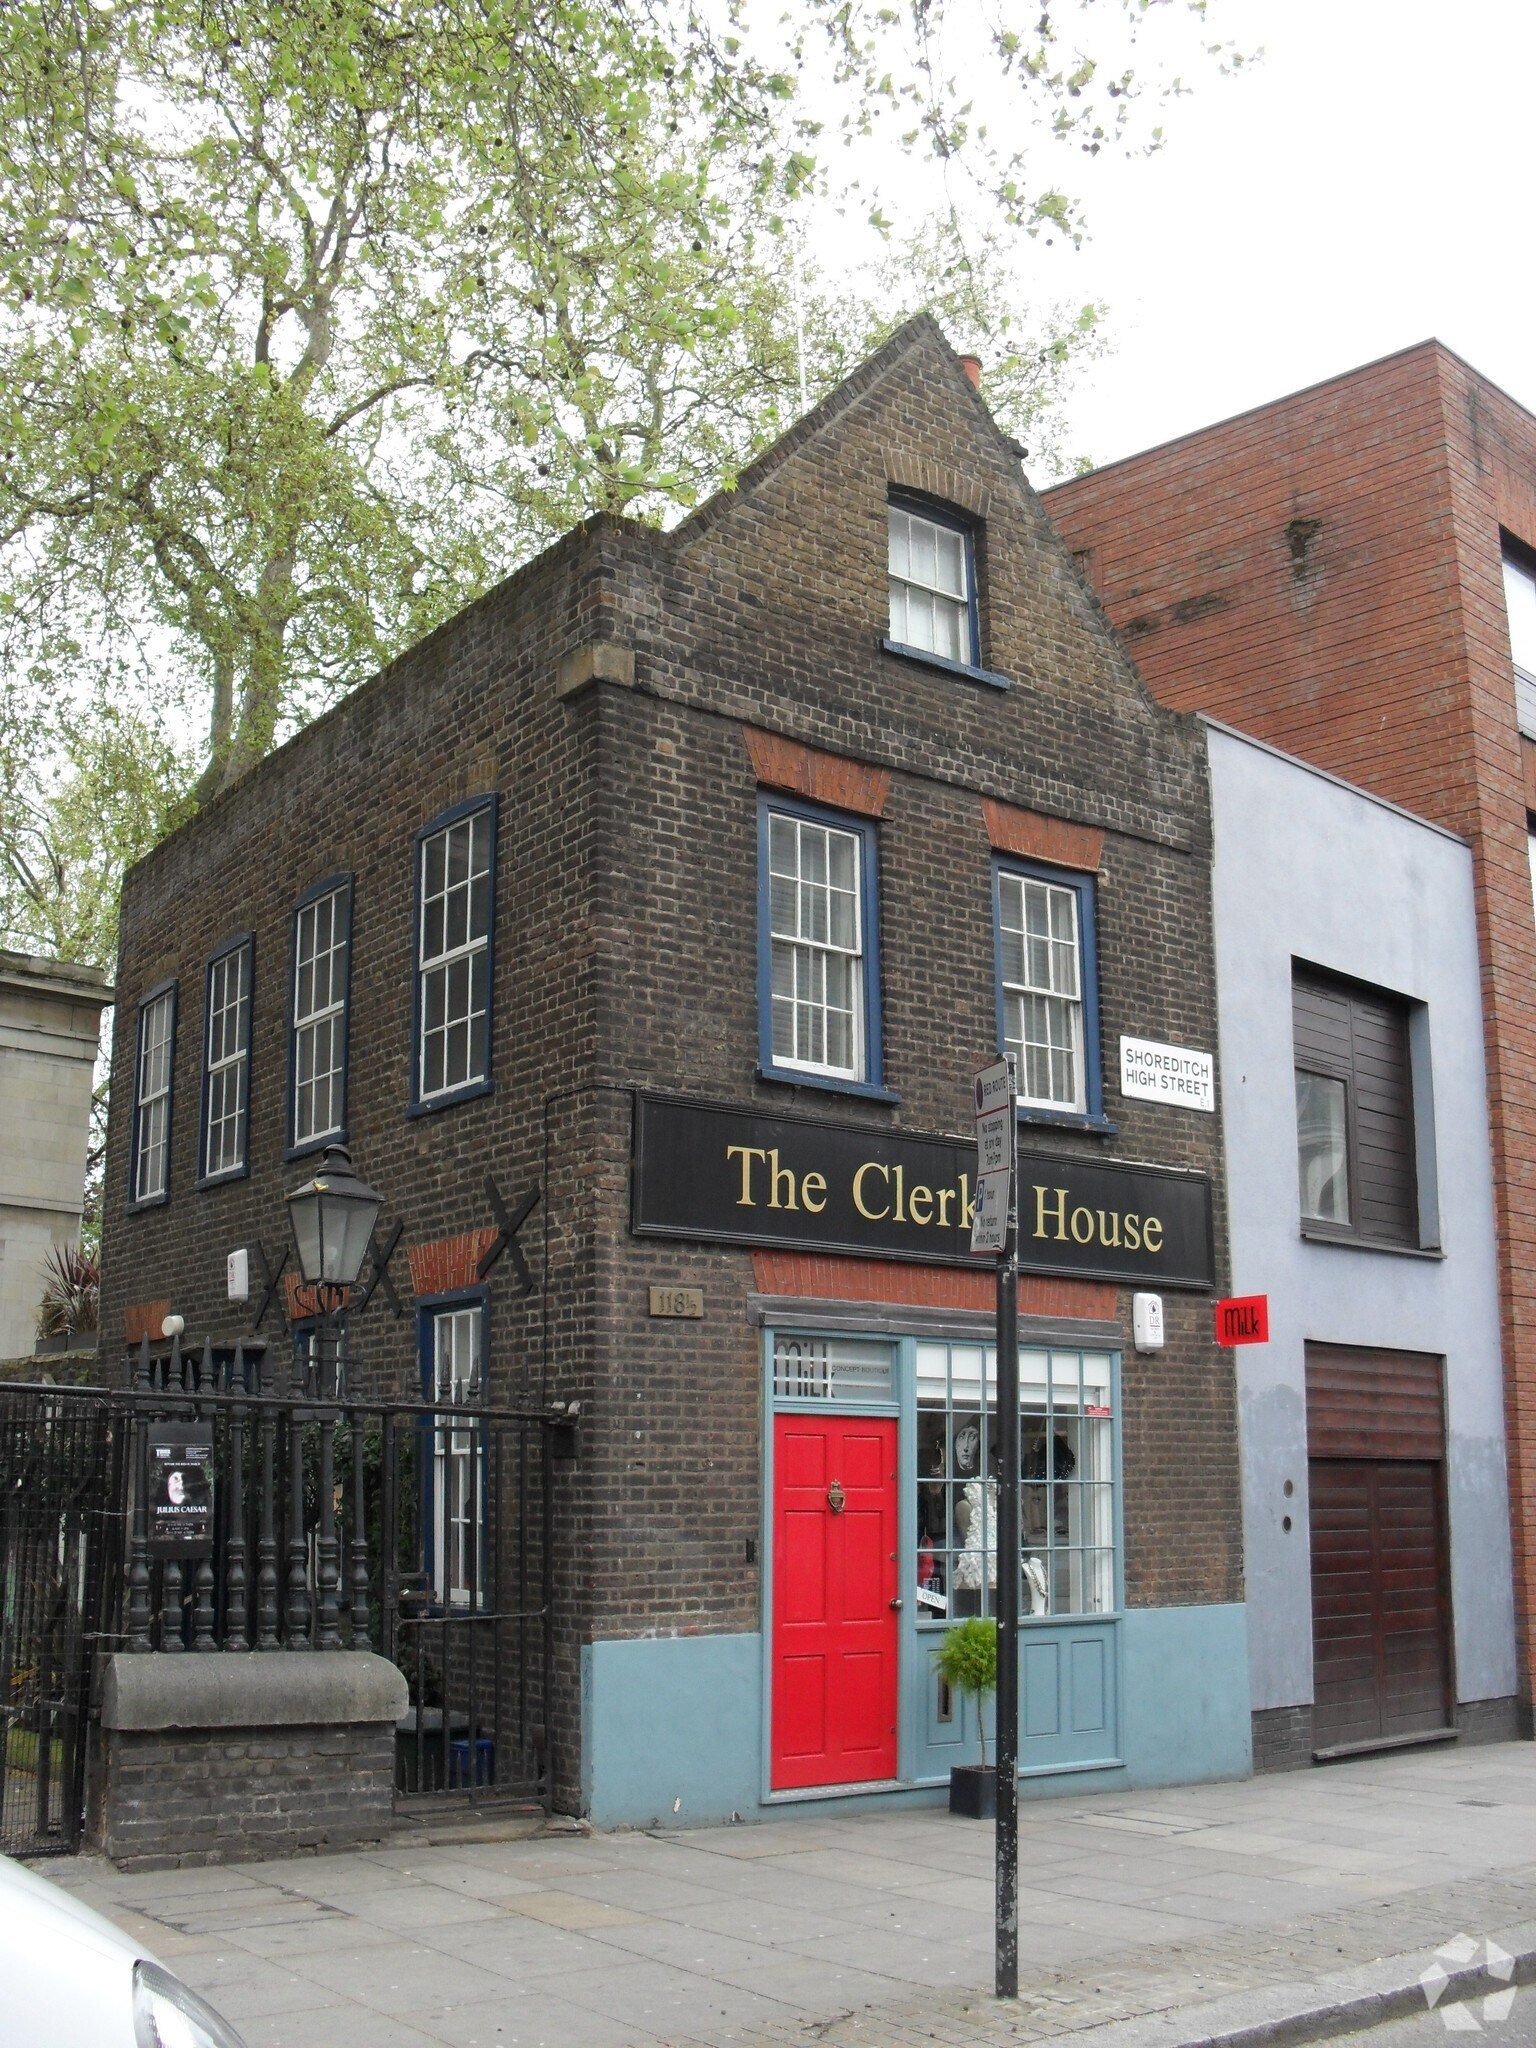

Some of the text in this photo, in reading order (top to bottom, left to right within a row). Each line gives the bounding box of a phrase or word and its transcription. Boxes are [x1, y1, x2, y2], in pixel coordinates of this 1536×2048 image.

[1126, 1048, 1209, 1078] SHOREDITCH
[984, 1076, 1006, 1096] RED ROUTE
[1126, 1068, 1208, 1097] HIGH STREET
[988, 1118, 1003, 1132] stopping
[727, 1145, 1163, 1253] The Clerk House
[977, 1183, 984, 1210] P
[989, 1232, 1000, 1243] hours
[832, 1364, 860, 1373] CONCEPT
[156, 1505, 208, 1514] JULIUS CAESAR
[921, 1592, 940, 1604] OPEN
